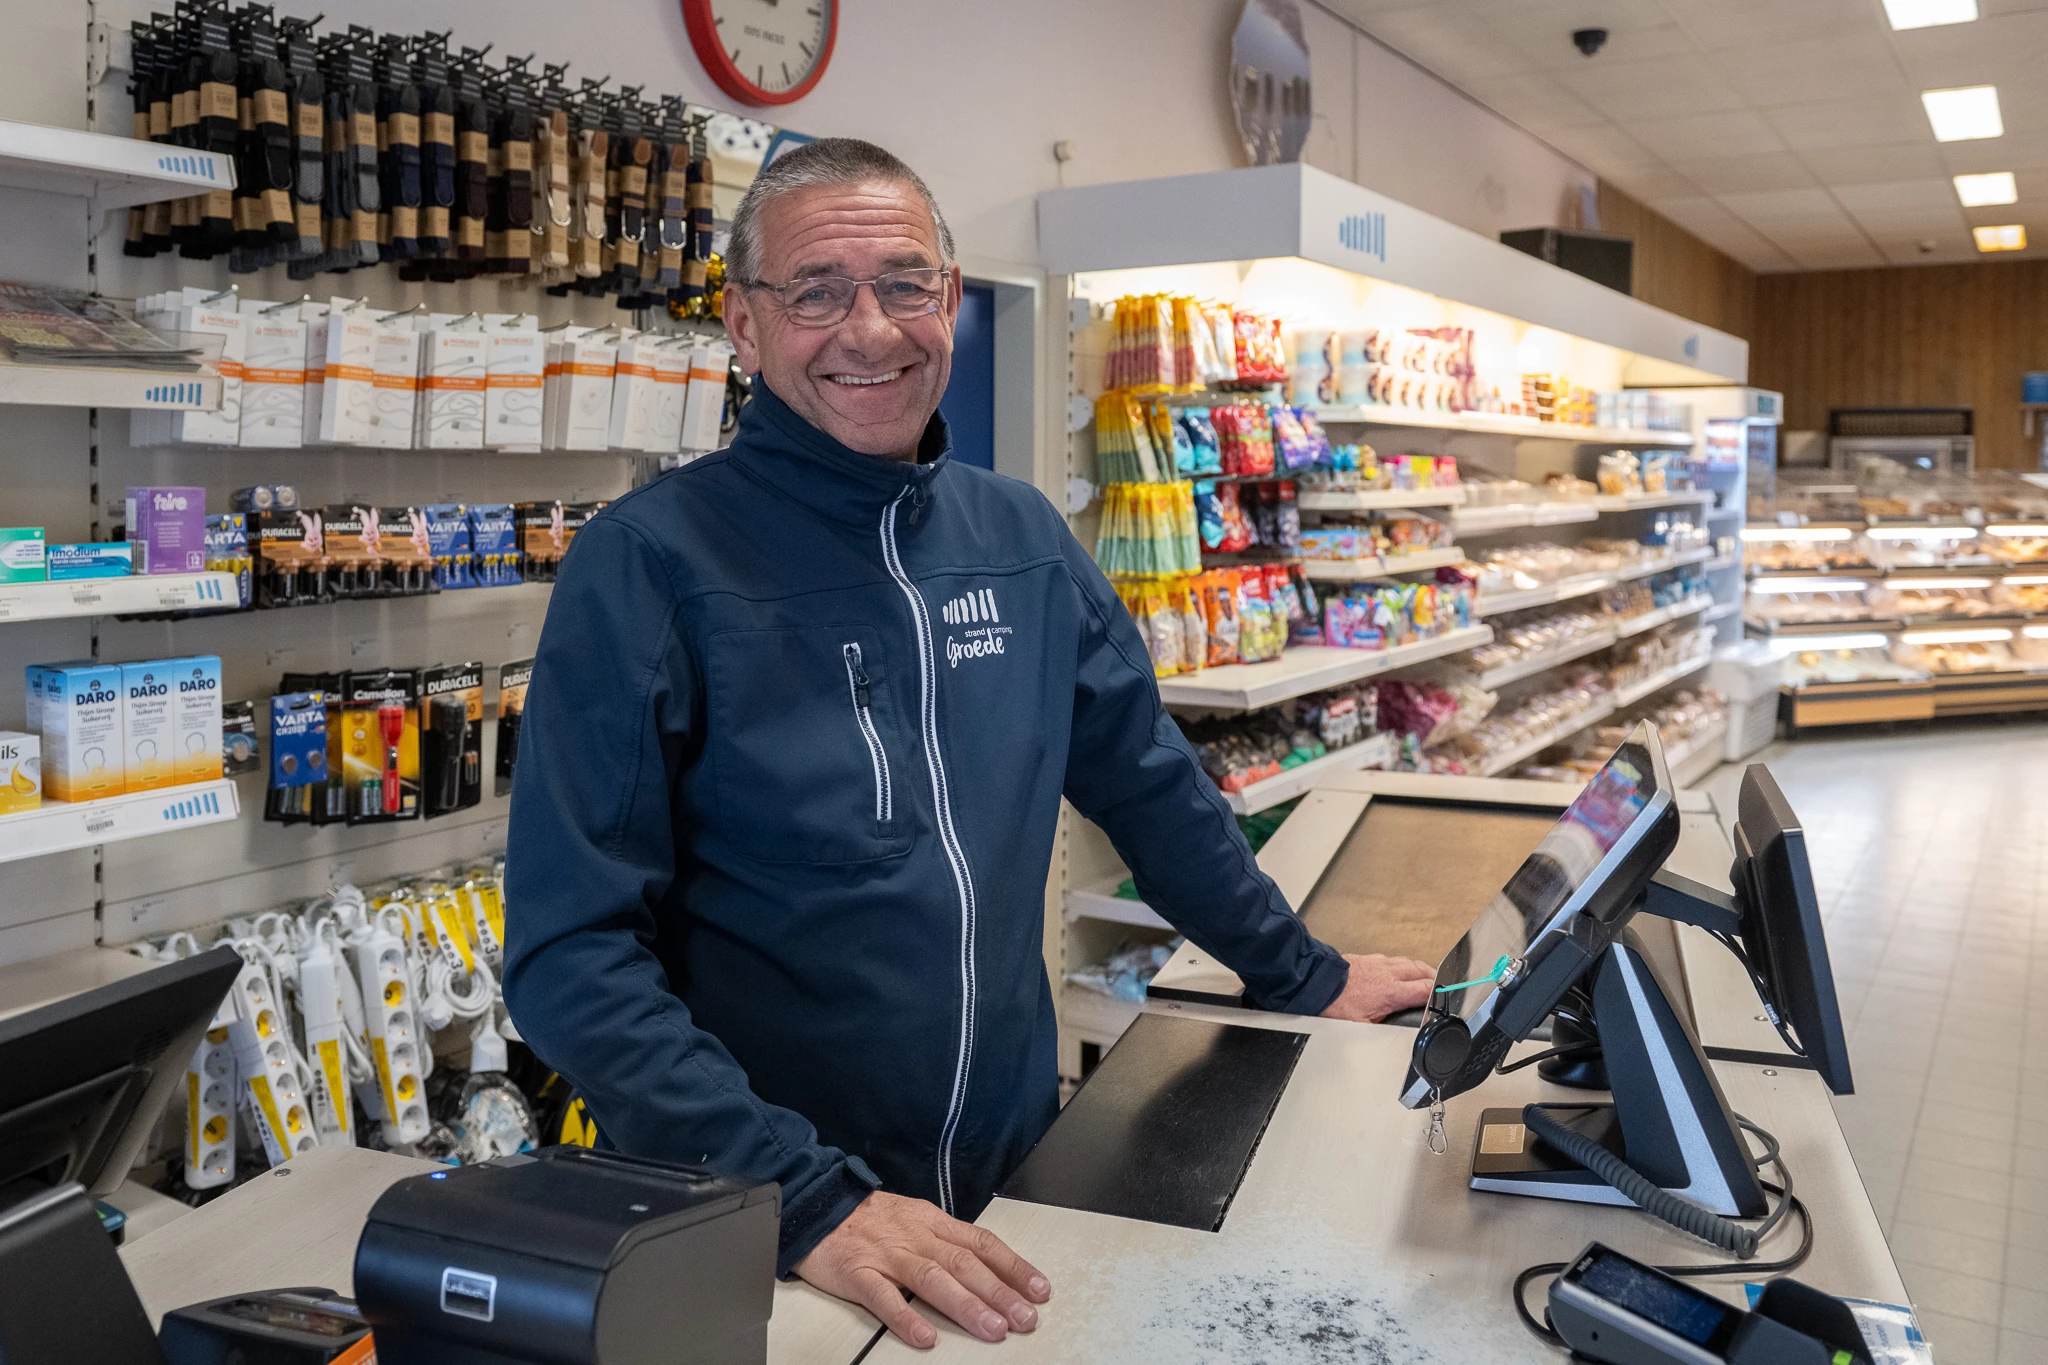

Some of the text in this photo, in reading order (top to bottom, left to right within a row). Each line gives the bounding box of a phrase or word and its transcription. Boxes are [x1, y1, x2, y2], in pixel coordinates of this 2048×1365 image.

[261, 528, 302, 537] DURACELL
[325, 522, 363, 531] DURACELL
[379, 524, 414, 532] DURACELL
[427, 521, 468, 532] VARTA
[475, 521, 514, 532] VARTA
[52, 547, 101, 558] Imodium
[965, 626, 1013, 638] strand camping
[946, 627, 1005, 669] Groede
[180, 678, 216, 692] DARO
[427, 673, 480, 694] DURACELL
[130, 684, 167, 698] DARO
[353, 689, 406, 701] Camelion
[76, 690, 115, 705] DARO
[77, 706, 115, 718] Thijm Siroop
[135, 706, 163, 716] Suikervrij
[82, 714, 111, 724] Suikervrij
[275, 711, 325, 727] VARTA
[275, 725, 306, 737] CR2025
